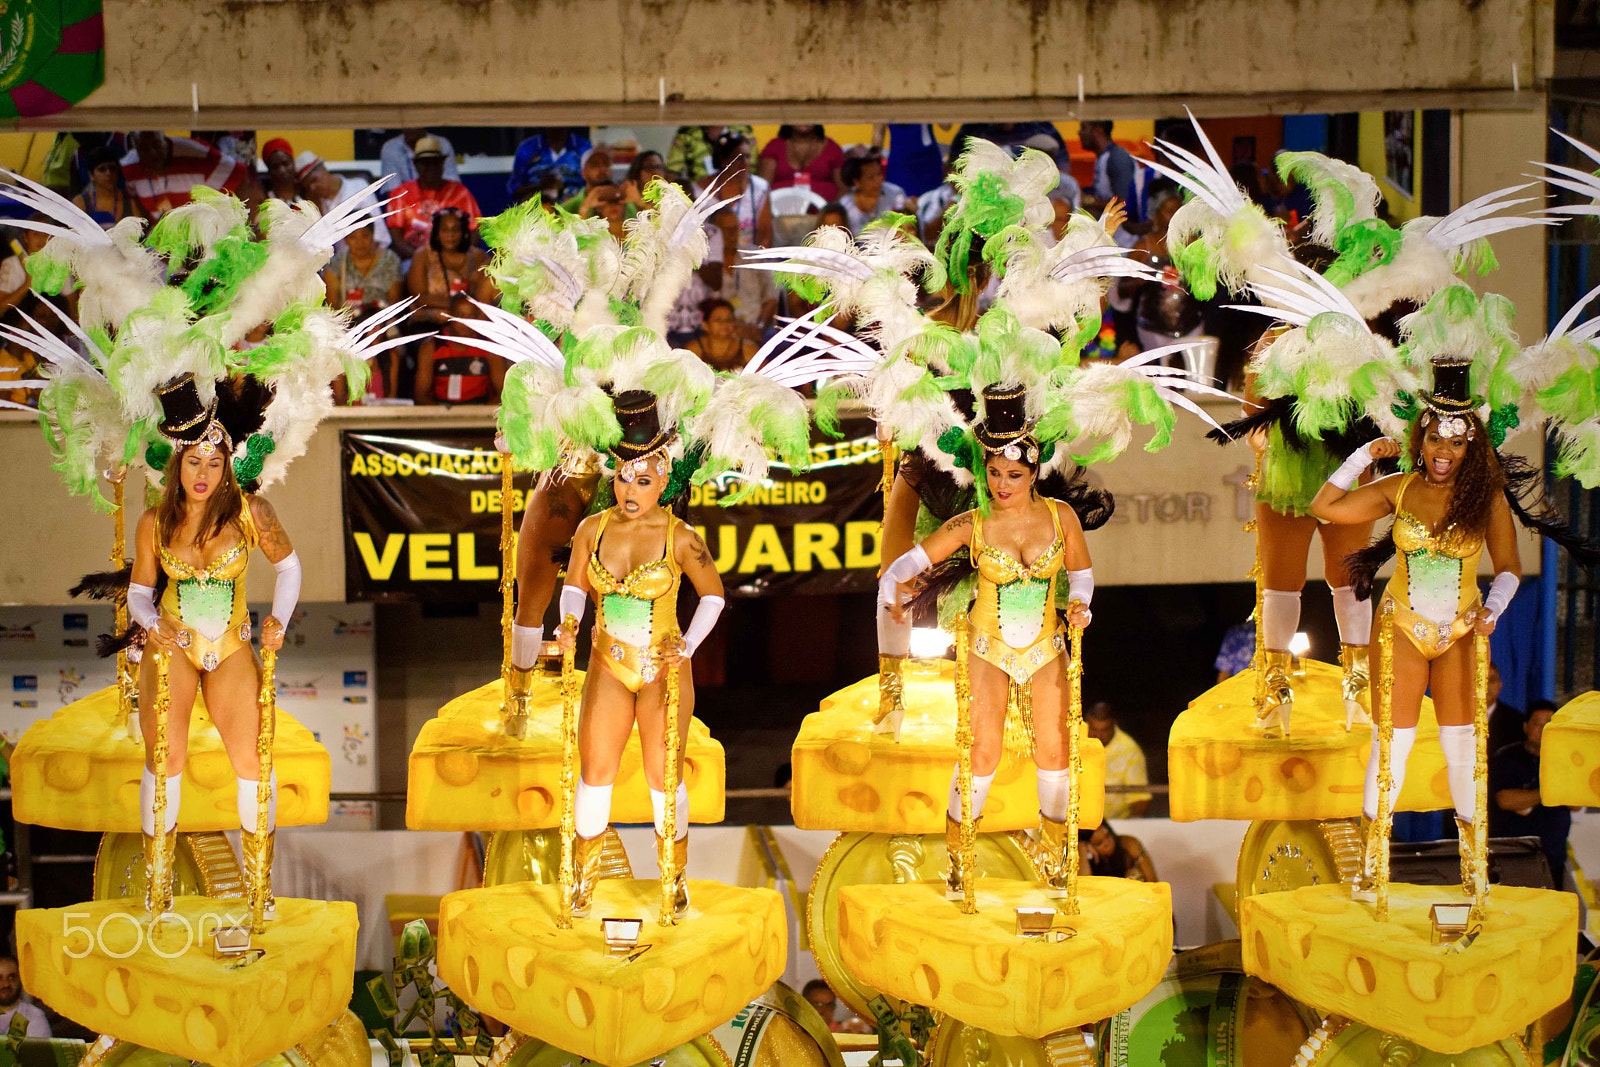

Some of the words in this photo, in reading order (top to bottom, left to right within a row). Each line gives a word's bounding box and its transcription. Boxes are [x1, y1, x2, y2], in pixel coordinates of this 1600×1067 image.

[470, 489, 503, 514] DE
[688, 482, 717, 507] DE
[353, 532, 519, 581] VEL
